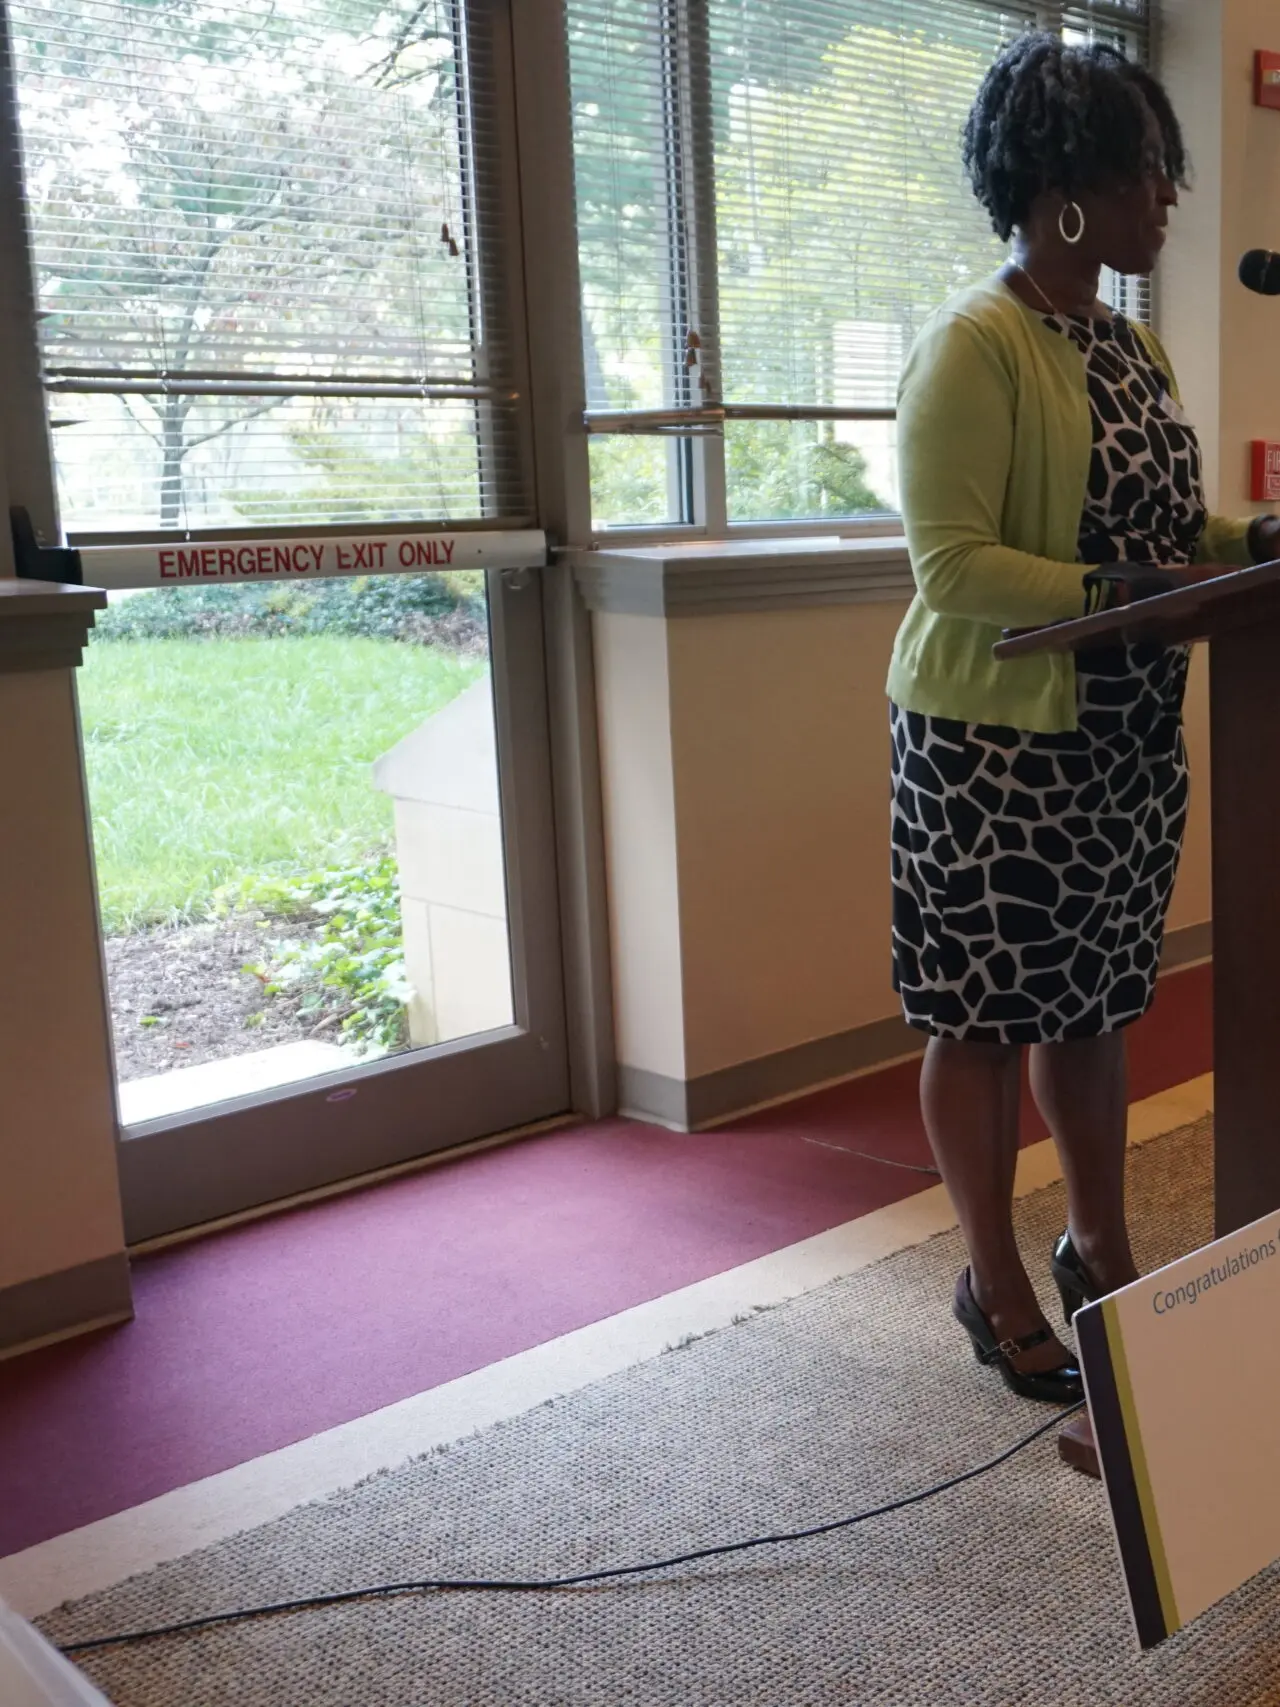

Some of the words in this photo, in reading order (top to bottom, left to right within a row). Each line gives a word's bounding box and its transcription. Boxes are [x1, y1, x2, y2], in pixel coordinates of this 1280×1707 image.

[159, 545, 324, 578] EMERGENCY
[337, 542, 387, 569] EXIT
[400, 540, 455, 567] ONLY
[1152, 1239, 1277, 1315] Congratulations
